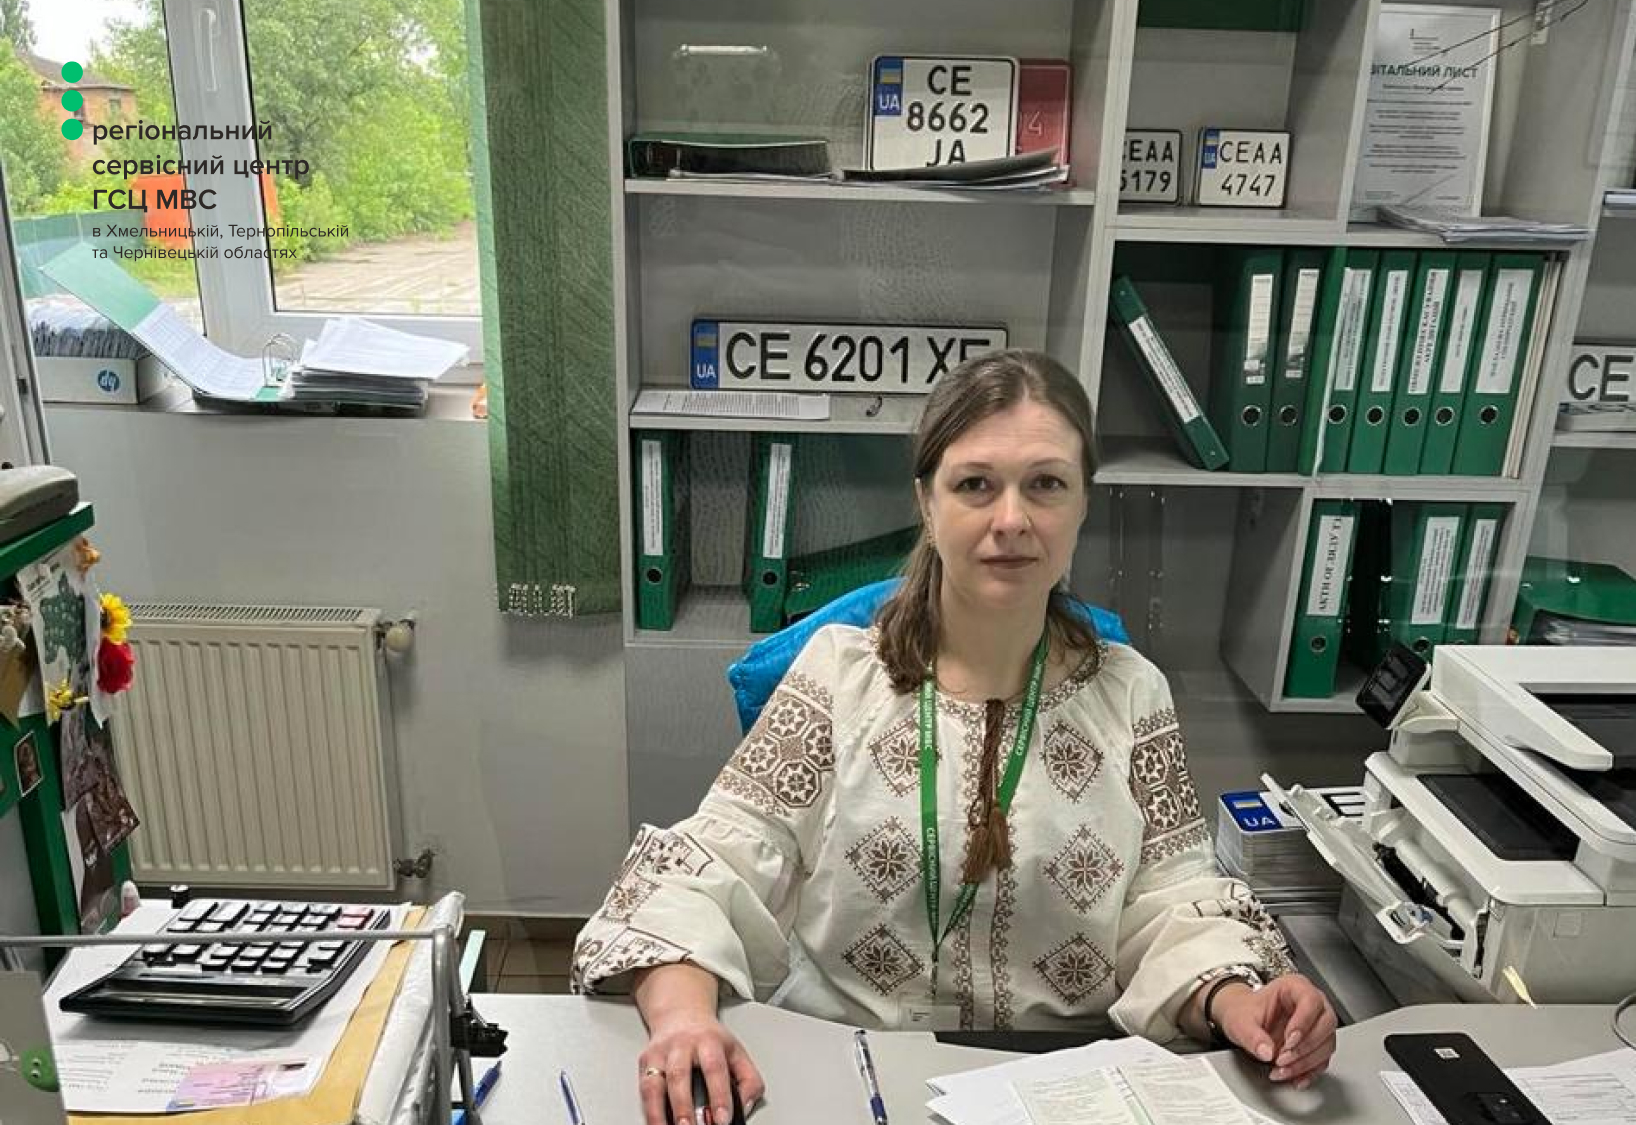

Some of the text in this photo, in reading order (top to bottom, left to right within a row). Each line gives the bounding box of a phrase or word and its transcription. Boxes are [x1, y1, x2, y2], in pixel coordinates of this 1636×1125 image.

[928, 65, 972, 96] CE
[1443, 66, 1478, 78] ЛИСТ
[878, 93, 900, 110] UA
[907, 101, 989, 133] 8662
[926, 139, 966, 167] JA
[1122, 139, 1174, 162] EAA
[1220, 141, 1282, 164] CEAA
[1221, 174, 1276, 196] 4747
[726, 332, 790, 380] CE
[804, 334, 908, 383] 6201
[696, 364, 716, 378] UA
[1569, 353, 1634, 402] CE
[1242, 816, 1276, 828] UA
